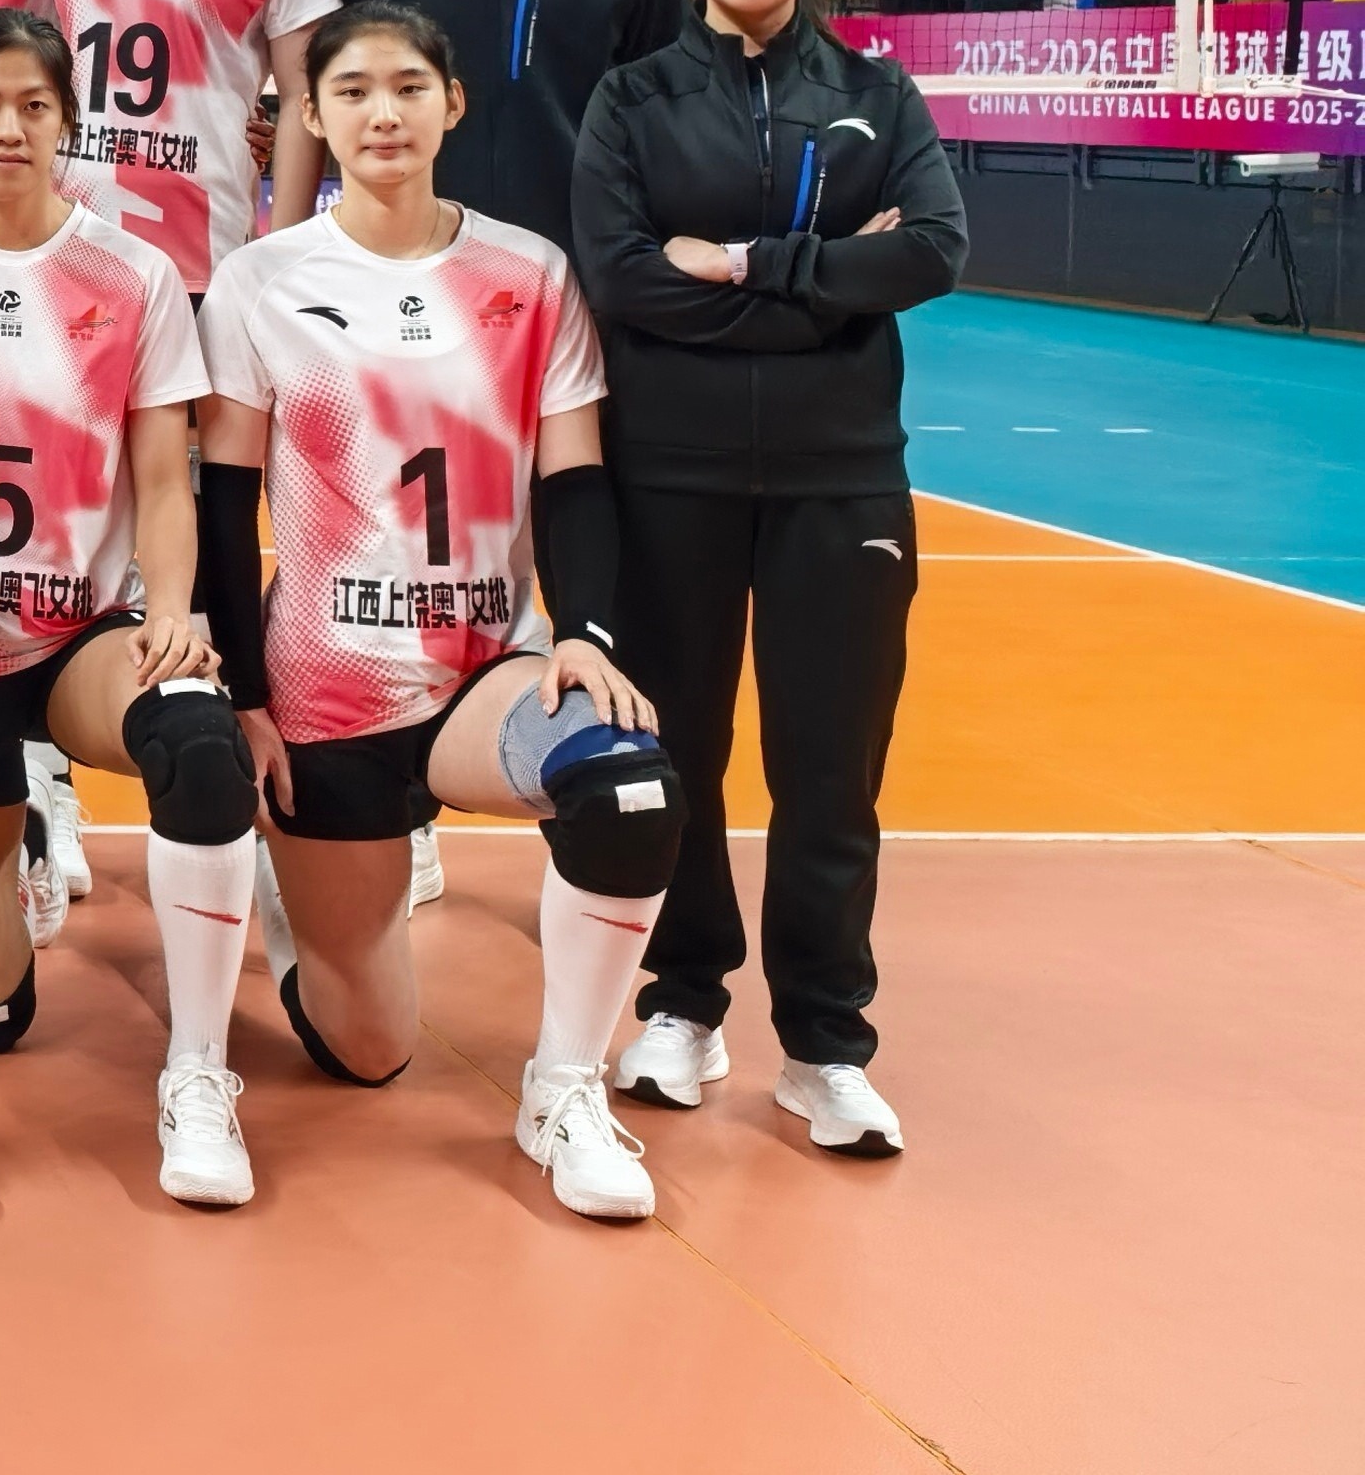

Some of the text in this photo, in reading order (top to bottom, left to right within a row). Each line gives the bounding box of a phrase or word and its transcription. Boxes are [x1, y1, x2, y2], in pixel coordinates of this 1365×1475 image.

[77, 21, 170, 118] 19
[968, 94, 1030, 116] CHINA
[1039, 94, 1170, 119] VOLLEYBALL
[1181, 97, 1275, 122] LEAGUE
[400, 447, 451, 567] 1
